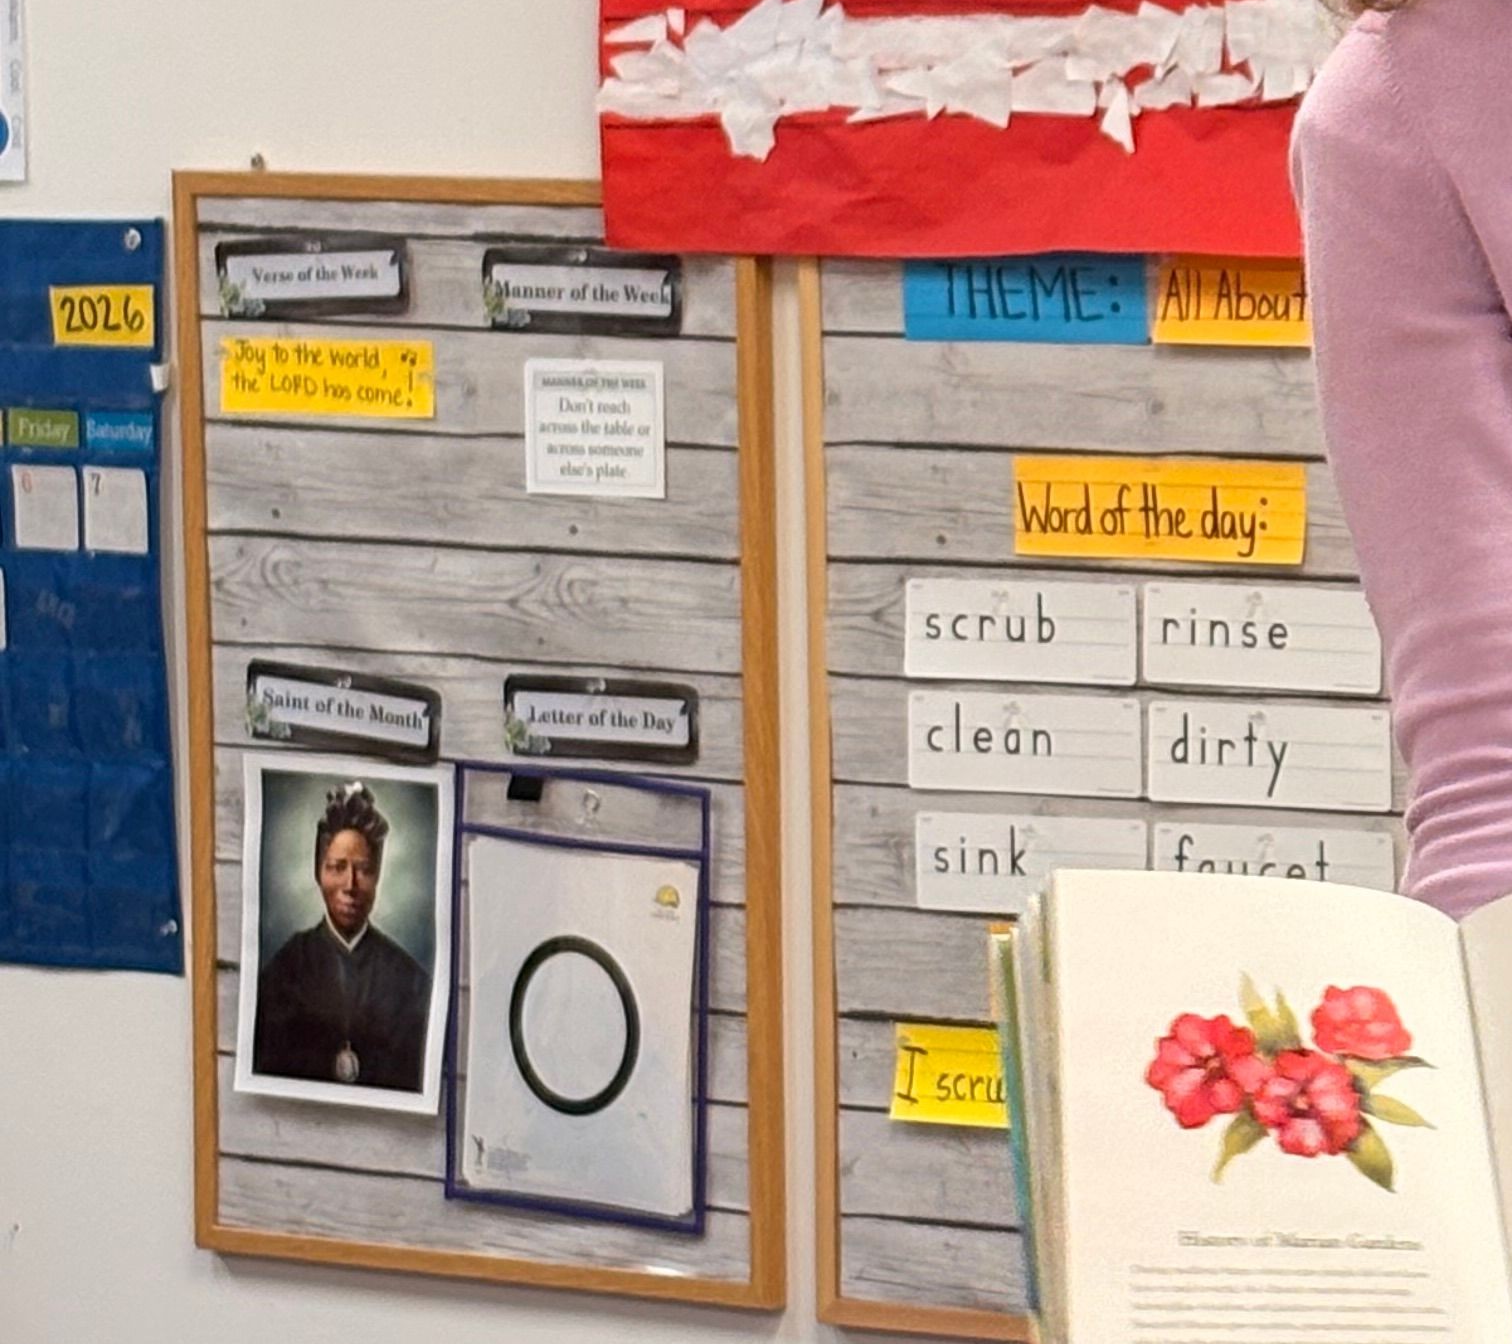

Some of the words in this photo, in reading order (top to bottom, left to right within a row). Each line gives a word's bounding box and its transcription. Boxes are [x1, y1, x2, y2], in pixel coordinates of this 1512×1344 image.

[252, 267, 294, 284] Verse
[298, 264, 312, 282] of
[315, 264, 338, 281] the
[340, 264, 378, 281] Week
[495, 280, 565, 301] Manner
[569, 284, 589, 302] of
[592, 285, 618, 303] the
[623, 284, 671, 305] Week
[942, 263, 1121, 322] THEME:
[1162, 268, 1201, 322] All
[1215, 268, 1309, 322] About
[60, 294, 144, 333] 2026
[234, 340, 266, 376] Joy
[273, 343, 290, 364] to
[294, 343, 323, 362] the
[232, 373, 260, 393] the
[323, 379, 352, 401] has
[19, 417, 70, 442] Friday
[86, 418, 152, 446] Saturday
[1016, 480, 1091, 536] Word
[1099, 482, 1132, 534] of
[1137, 481, 1194, 540] the
[1200, 484, 1268, 558] day:
[924, 592, 1056, 646] scrub
[1161, 607, 1289, 650] rinse
[262, 687, 309, 711] Saint
[315, 697, 335, 714] of
[337, 699, 364, 720] the
[369, 705, 423, 730] Month
[528, 705, 582, 726] Letter
[588, 708, 605, 726] of
[610, 710, 638, 728] the
[642, 711, 675, 734] Day
[926, 701, 1053, 756] clean
[1169, 711, 1289, 799] dirty
[933, 823, 1028, 876] sink
[509, 934, 641, 1116] O
[897, 1046, 928, 1105] I
